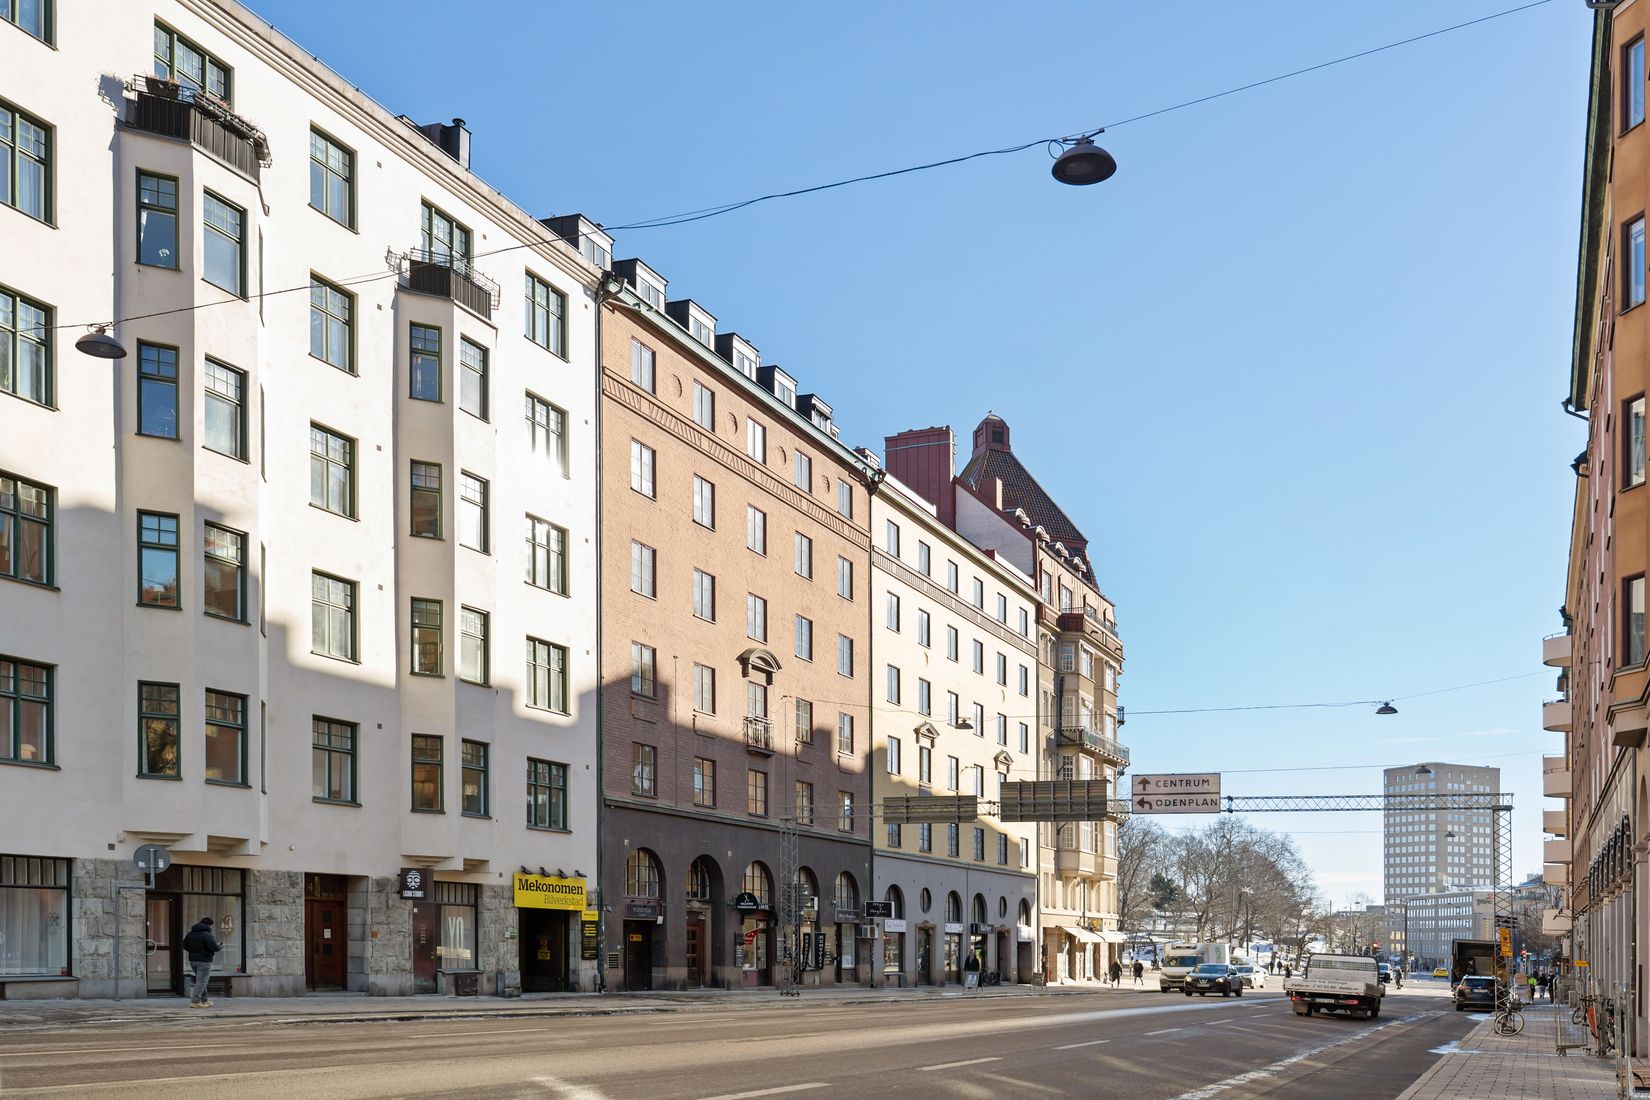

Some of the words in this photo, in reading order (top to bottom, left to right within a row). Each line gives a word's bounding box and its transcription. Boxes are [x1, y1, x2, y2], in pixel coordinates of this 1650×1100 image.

[1155, 778, 1210, 788] CENTRUM
[1155, 798, 1218, 807] ODENPLAN
[518, 878, 583, 895] Mekonomen
[544, 894, 583, 906] Bilverkstad
